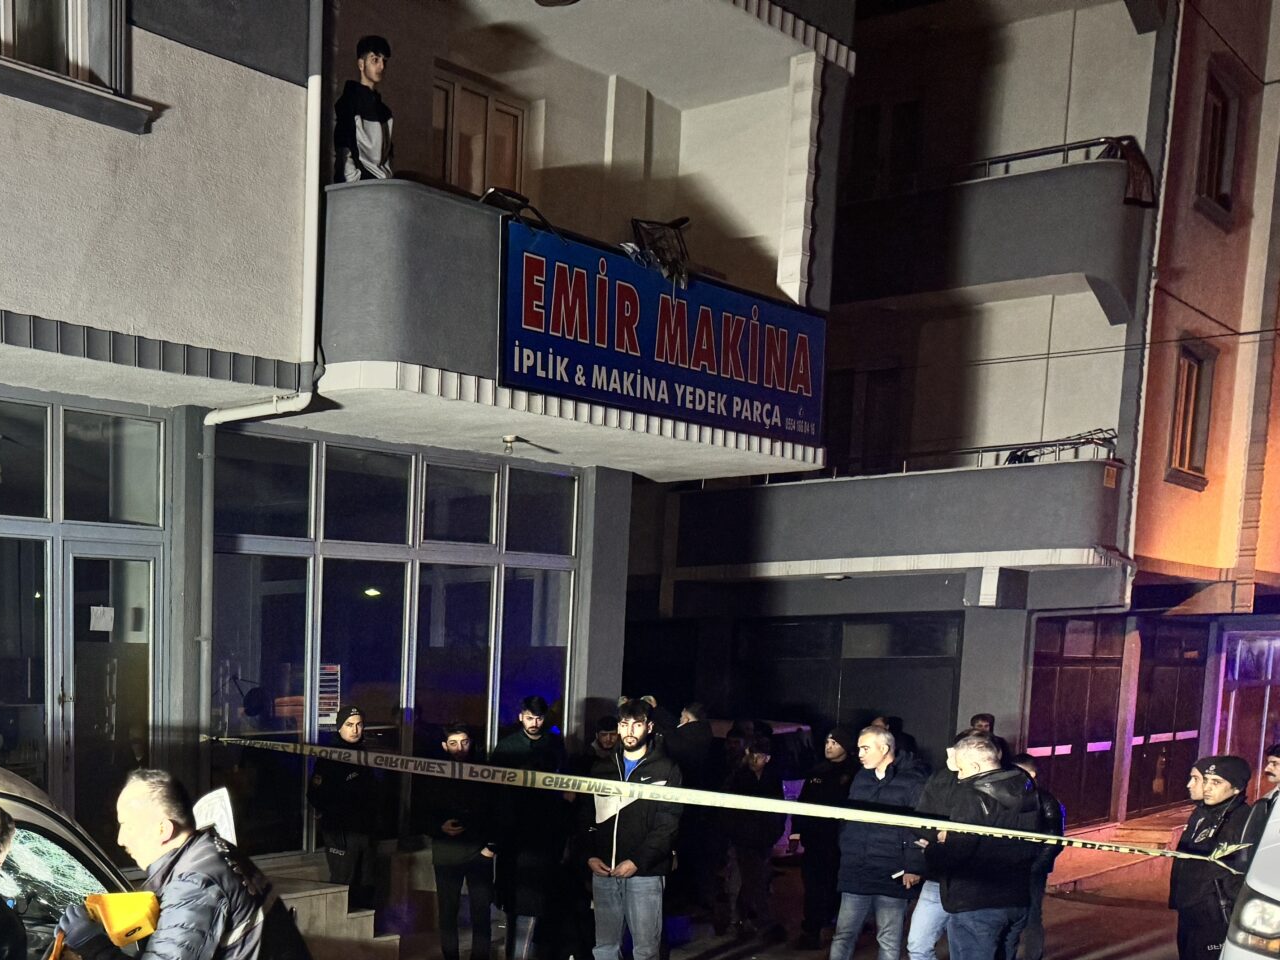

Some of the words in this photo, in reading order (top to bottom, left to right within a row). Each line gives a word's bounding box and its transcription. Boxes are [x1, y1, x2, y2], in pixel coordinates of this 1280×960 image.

[521, 251, 641, 357] EMİR
[654, 294, 812, 397] MAKİNA
[513, 340, 570, 383] İPLİK
[574, 364, 587, 387] &
[591, 364, 669, 404] MAKİNA
[674, 382, 727, 417] YEDEK
[732, 396, 782, 429] PARÇA
